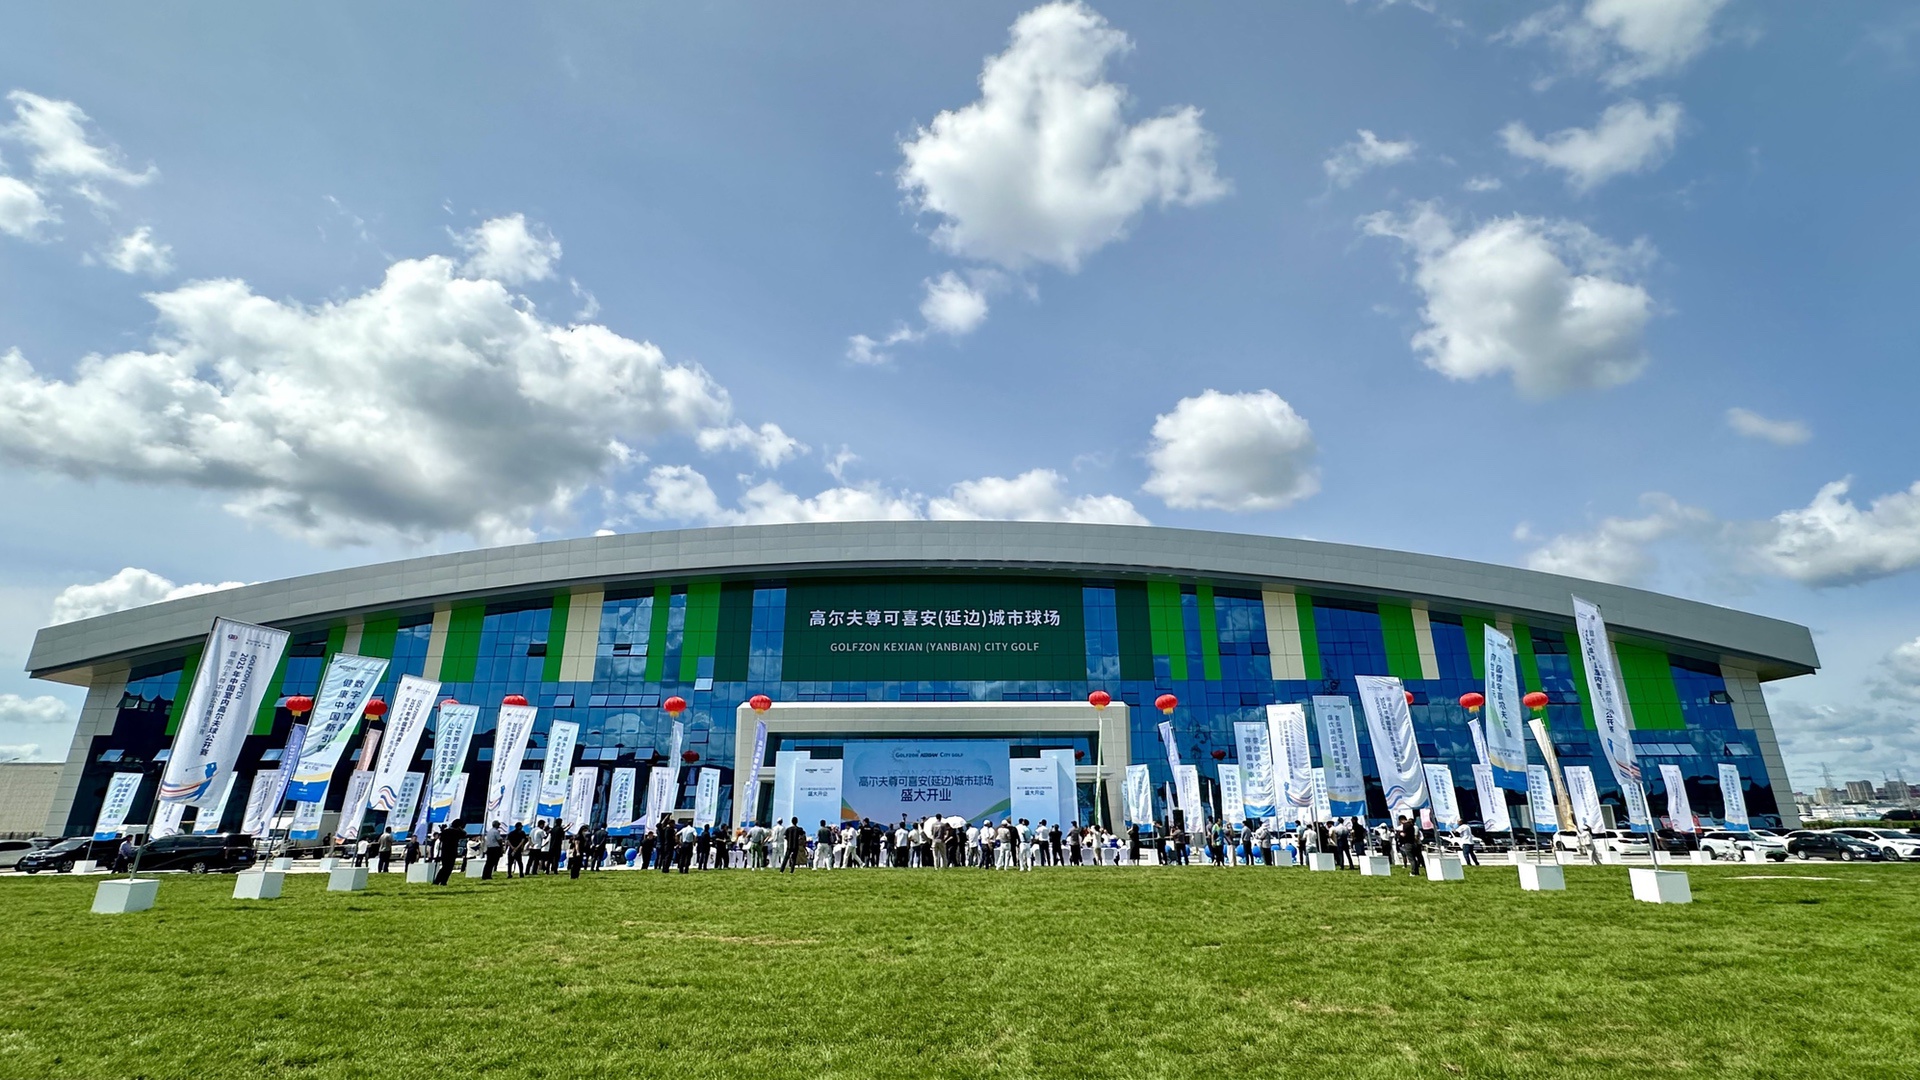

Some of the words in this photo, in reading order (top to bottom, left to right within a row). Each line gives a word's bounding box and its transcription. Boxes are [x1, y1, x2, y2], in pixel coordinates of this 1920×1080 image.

[809, 609, 1061, 628] 高尔夫尊可喜安(延边)城市球场
[830, 642, 881, 652] GOLFZON
[883, 642, 923, 652] KEXIAN
[925, 641, 981, 653] (YANBIAN)
[984, 642, 1009, 652] CITY
[1010, 642, 1040, 652] GOLF
[236, 652, 249, 670] 2025
[858, 775, 994, 787] 高尔夫尊可喜安(延边)城市球场
[900, 788, 952, 802] 盛大开业
